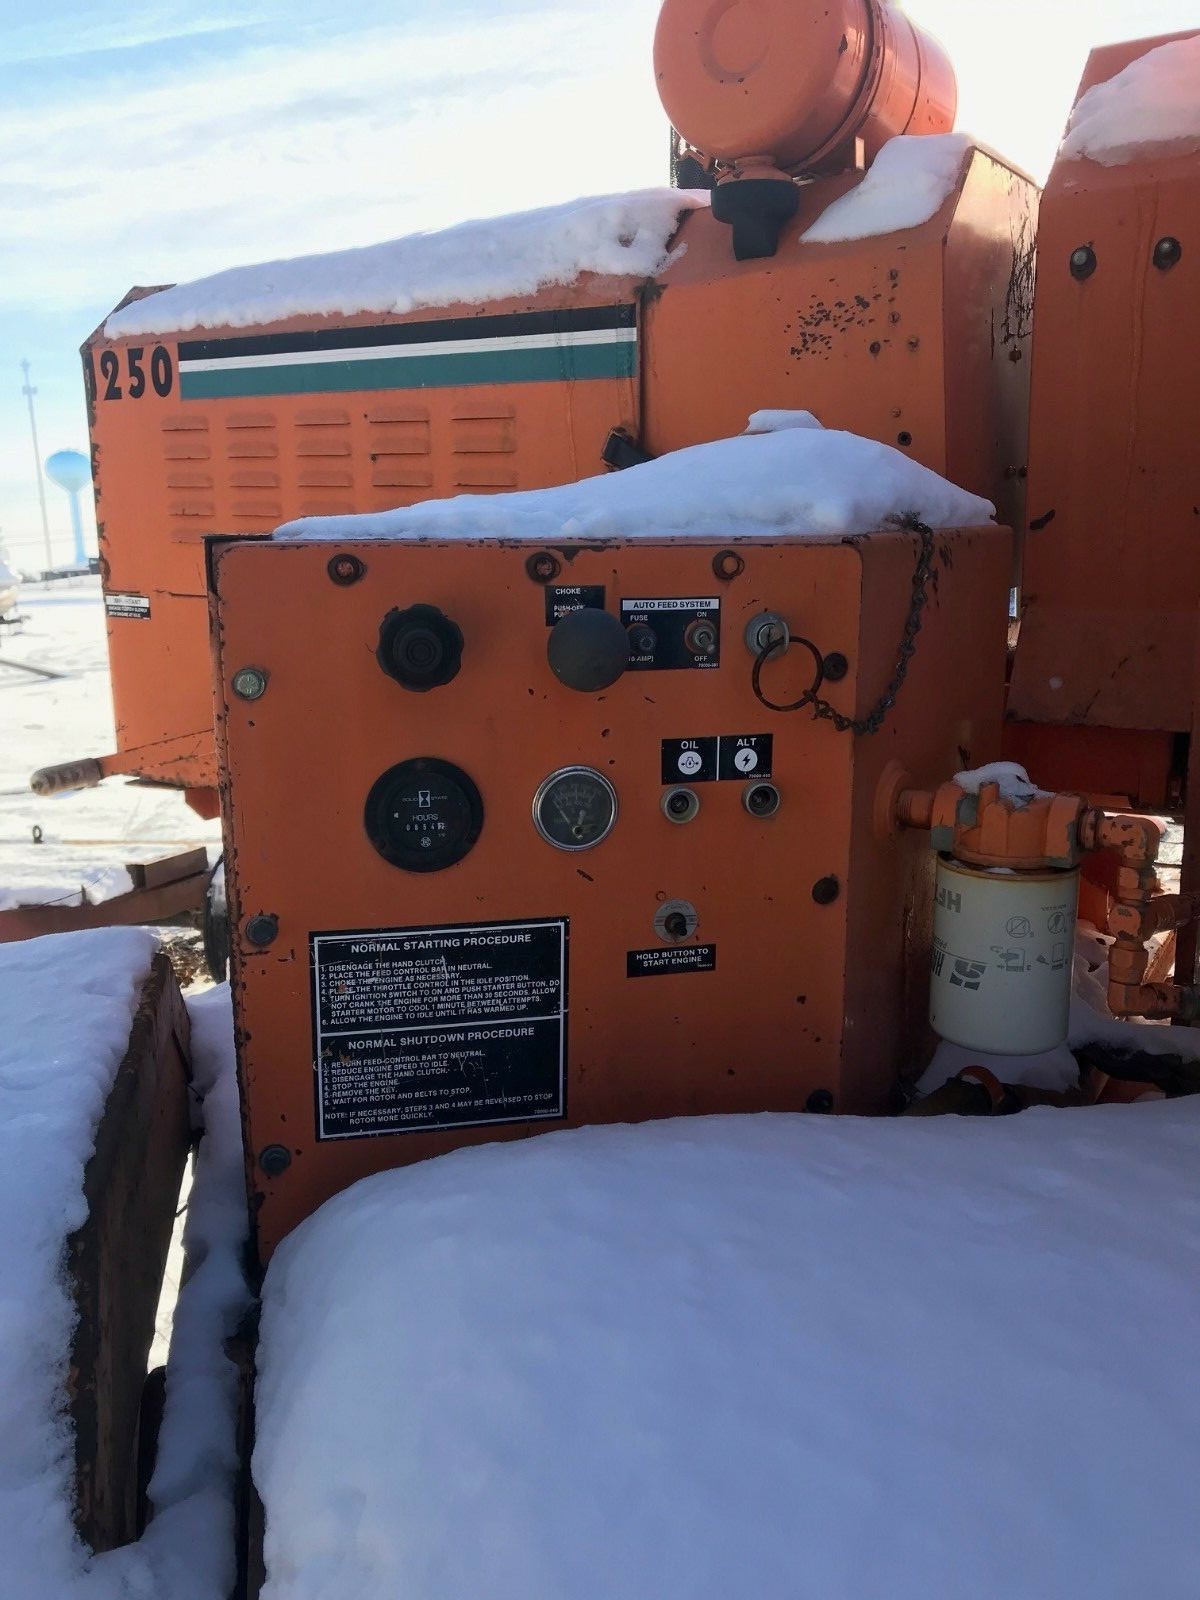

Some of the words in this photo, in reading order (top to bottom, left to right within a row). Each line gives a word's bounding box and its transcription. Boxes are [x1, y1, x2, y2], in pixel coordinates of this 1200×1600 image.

[680, 740, 699, 749] OIL
[737, 738, 757, 746] ALT
[351, 942, 400, 953] NORMAL
[404, 938, 460, 950] STARTING
[463, 934, 532, 946] PROCEDURE
[662, 950, 695, 958] BUTTON
[643, 959, 670, 967] START
[672, 956, 702, 964] ENGINE
[329, 963, 373, 972] DISENGAGE
[393, 966, 429, 975] CONTROL
[373, 983, 411, 992] THROTTLE
[413, 980, 450, 989] CONTROL
[352, 992, 387, 1000] IGNITION
[389, 990, 418, 998] SWITCH
[482, 983, 515, 991] STARTER
[393, 998, 422, 1006] ENGINE
[331, 1009, 365, 1017] STARTER
[367, 1007, 395, 1015] MOTOR
[437, 1002, 466, 1010] MINUTE
[330, 1017, 357, 1025] ALLOW
[374, 1014, 403, 1022] ENGINE
[484, 1005, 515, 1013] WARMED
[348, 1038, 397, 1050] NORMAL
[400, 1033, 464, 1046] SHUTDOWN
[467, 1028, 535, 1040] PROCEDURE
[331, 1068, 362, 1076] REDUCE
[364, 1065, 392, 1073] ENGINE
[331, 1074, 375, 1083] DISENGAGE
[332, 1090, 363, 1098] REMOVE
[369, 1094, 396, 1102] ROTOR
[485, 1096, 521, 1105] REVERSED
[350, 1116, 376, 1124] ROTOR
